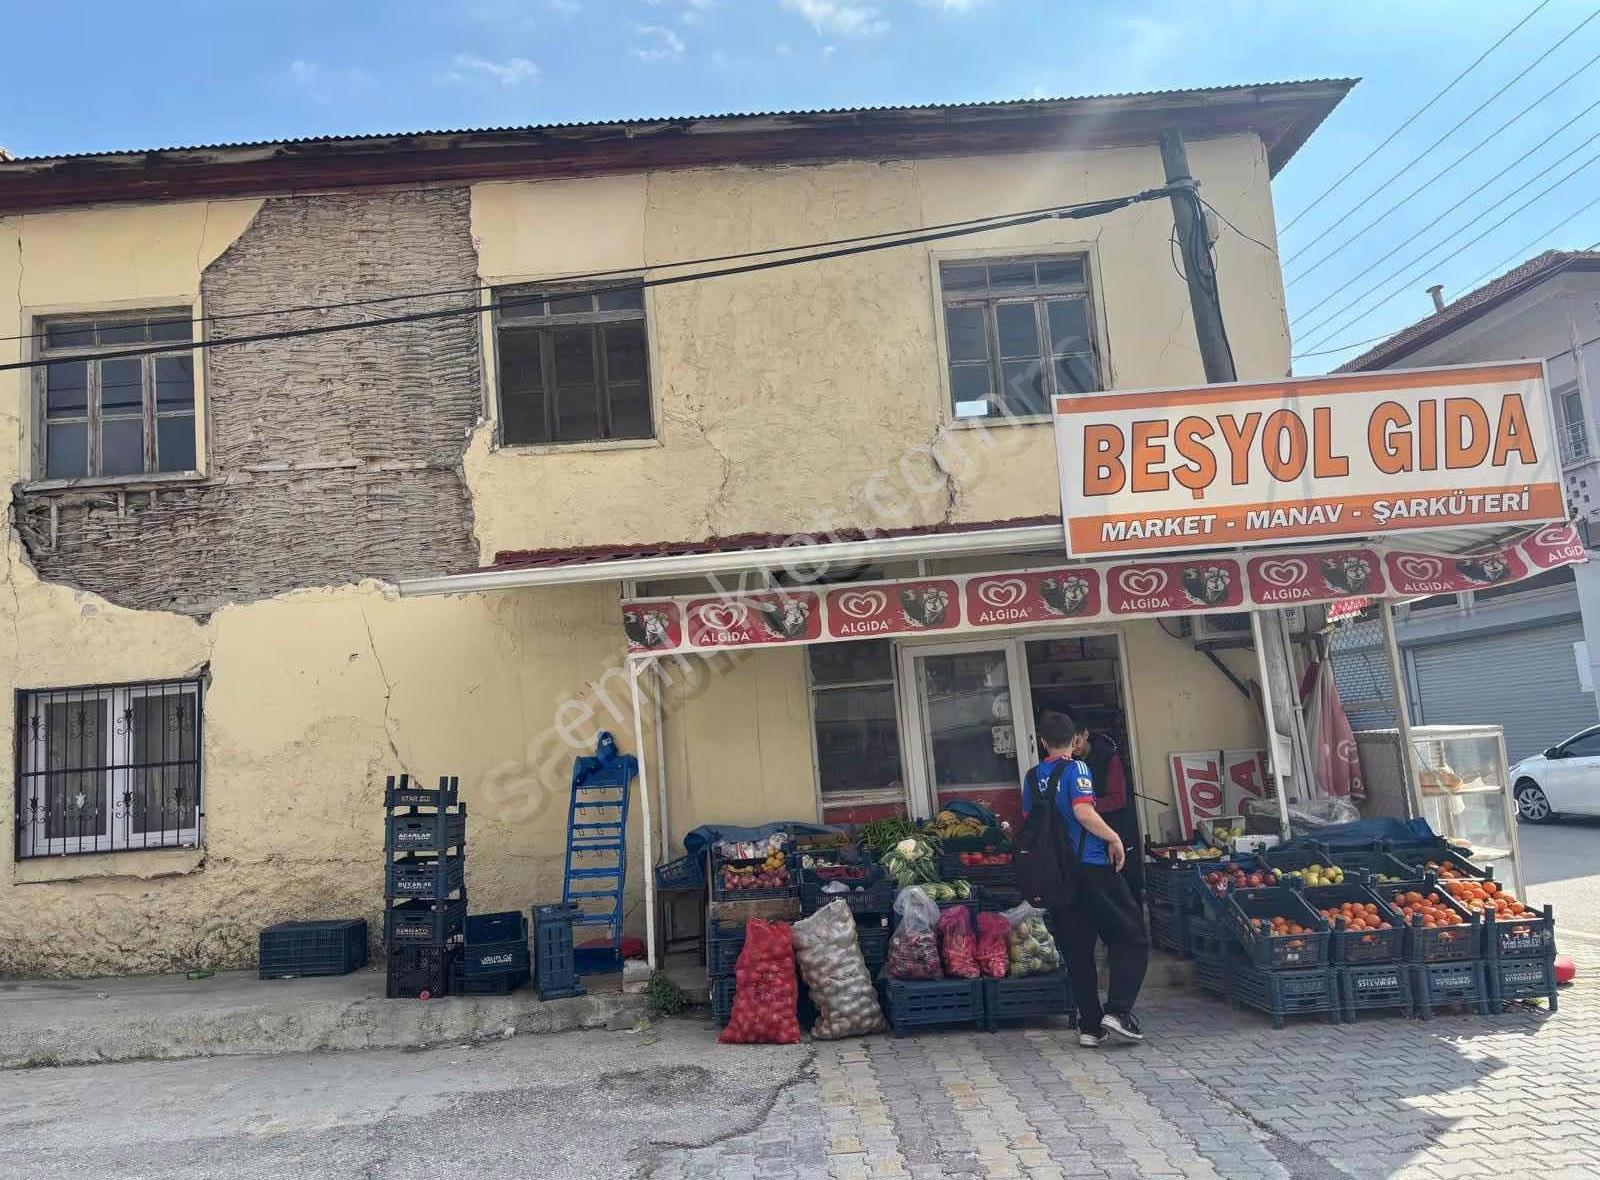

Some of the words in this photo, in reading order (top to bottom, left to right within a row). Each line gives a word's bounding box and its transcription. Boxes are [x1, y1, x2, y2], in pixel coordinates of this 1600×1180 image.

[1082, 408, 1350, 500] BEŞYOL
[1366, 393, 1538, 475] GIDA
[1101, 514, 1217, 543] MARKET
[1245, 502, 1344, 531] MANAV
[1371, 486, 1530, 525] ŞARKÜTERİ
